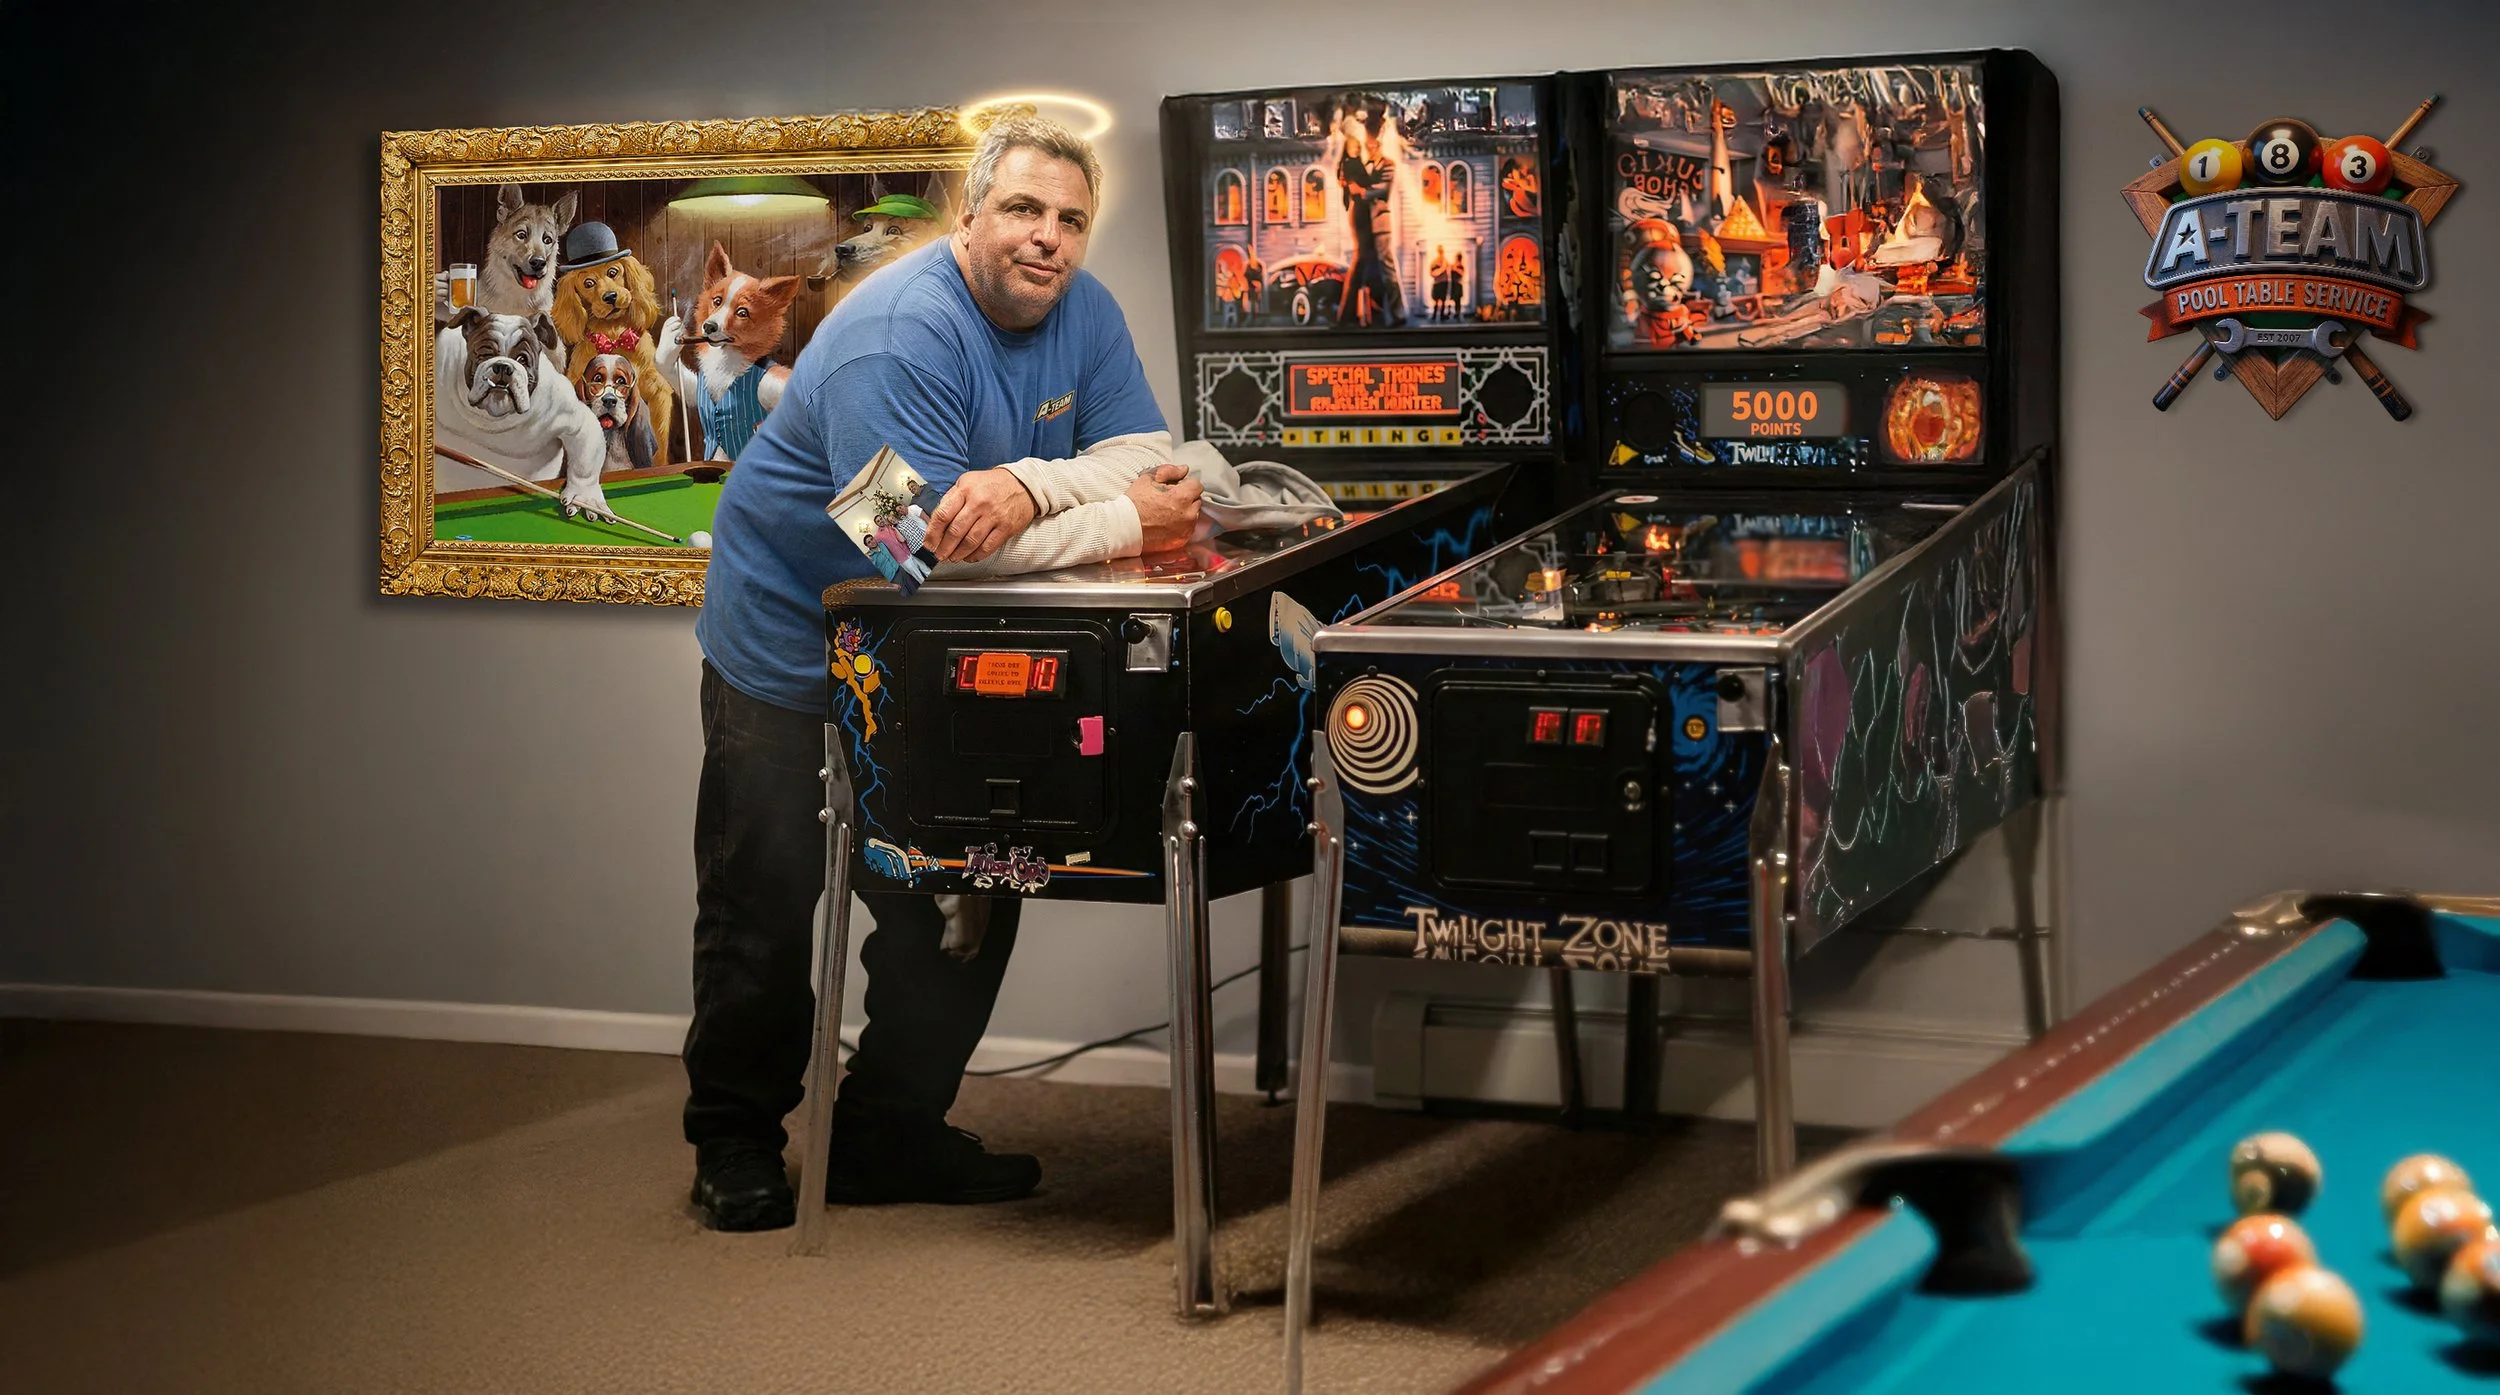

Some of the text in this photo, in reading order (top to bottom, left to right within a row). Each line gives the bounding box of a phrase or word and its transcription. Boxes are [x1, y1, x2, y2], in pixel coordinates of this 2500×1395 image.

[2198, 143, 2367, 179] 1 8 3
[2159, 198, 2416, 277] A-TEAM
[2177, 280, 2392, 320] POOL TABLE SERVICE
[2257, 332, 2302, 343] EST 2007
[1306, 366, 1375, 385] SPECIAL
[1731, 390, 1818, 421] 5000
[1313, 429, 1430, 443] THING
[1750, 422, 1802, 436] POINTS
[1404, 906, 1670, 960] TWILIGHT ZONE
